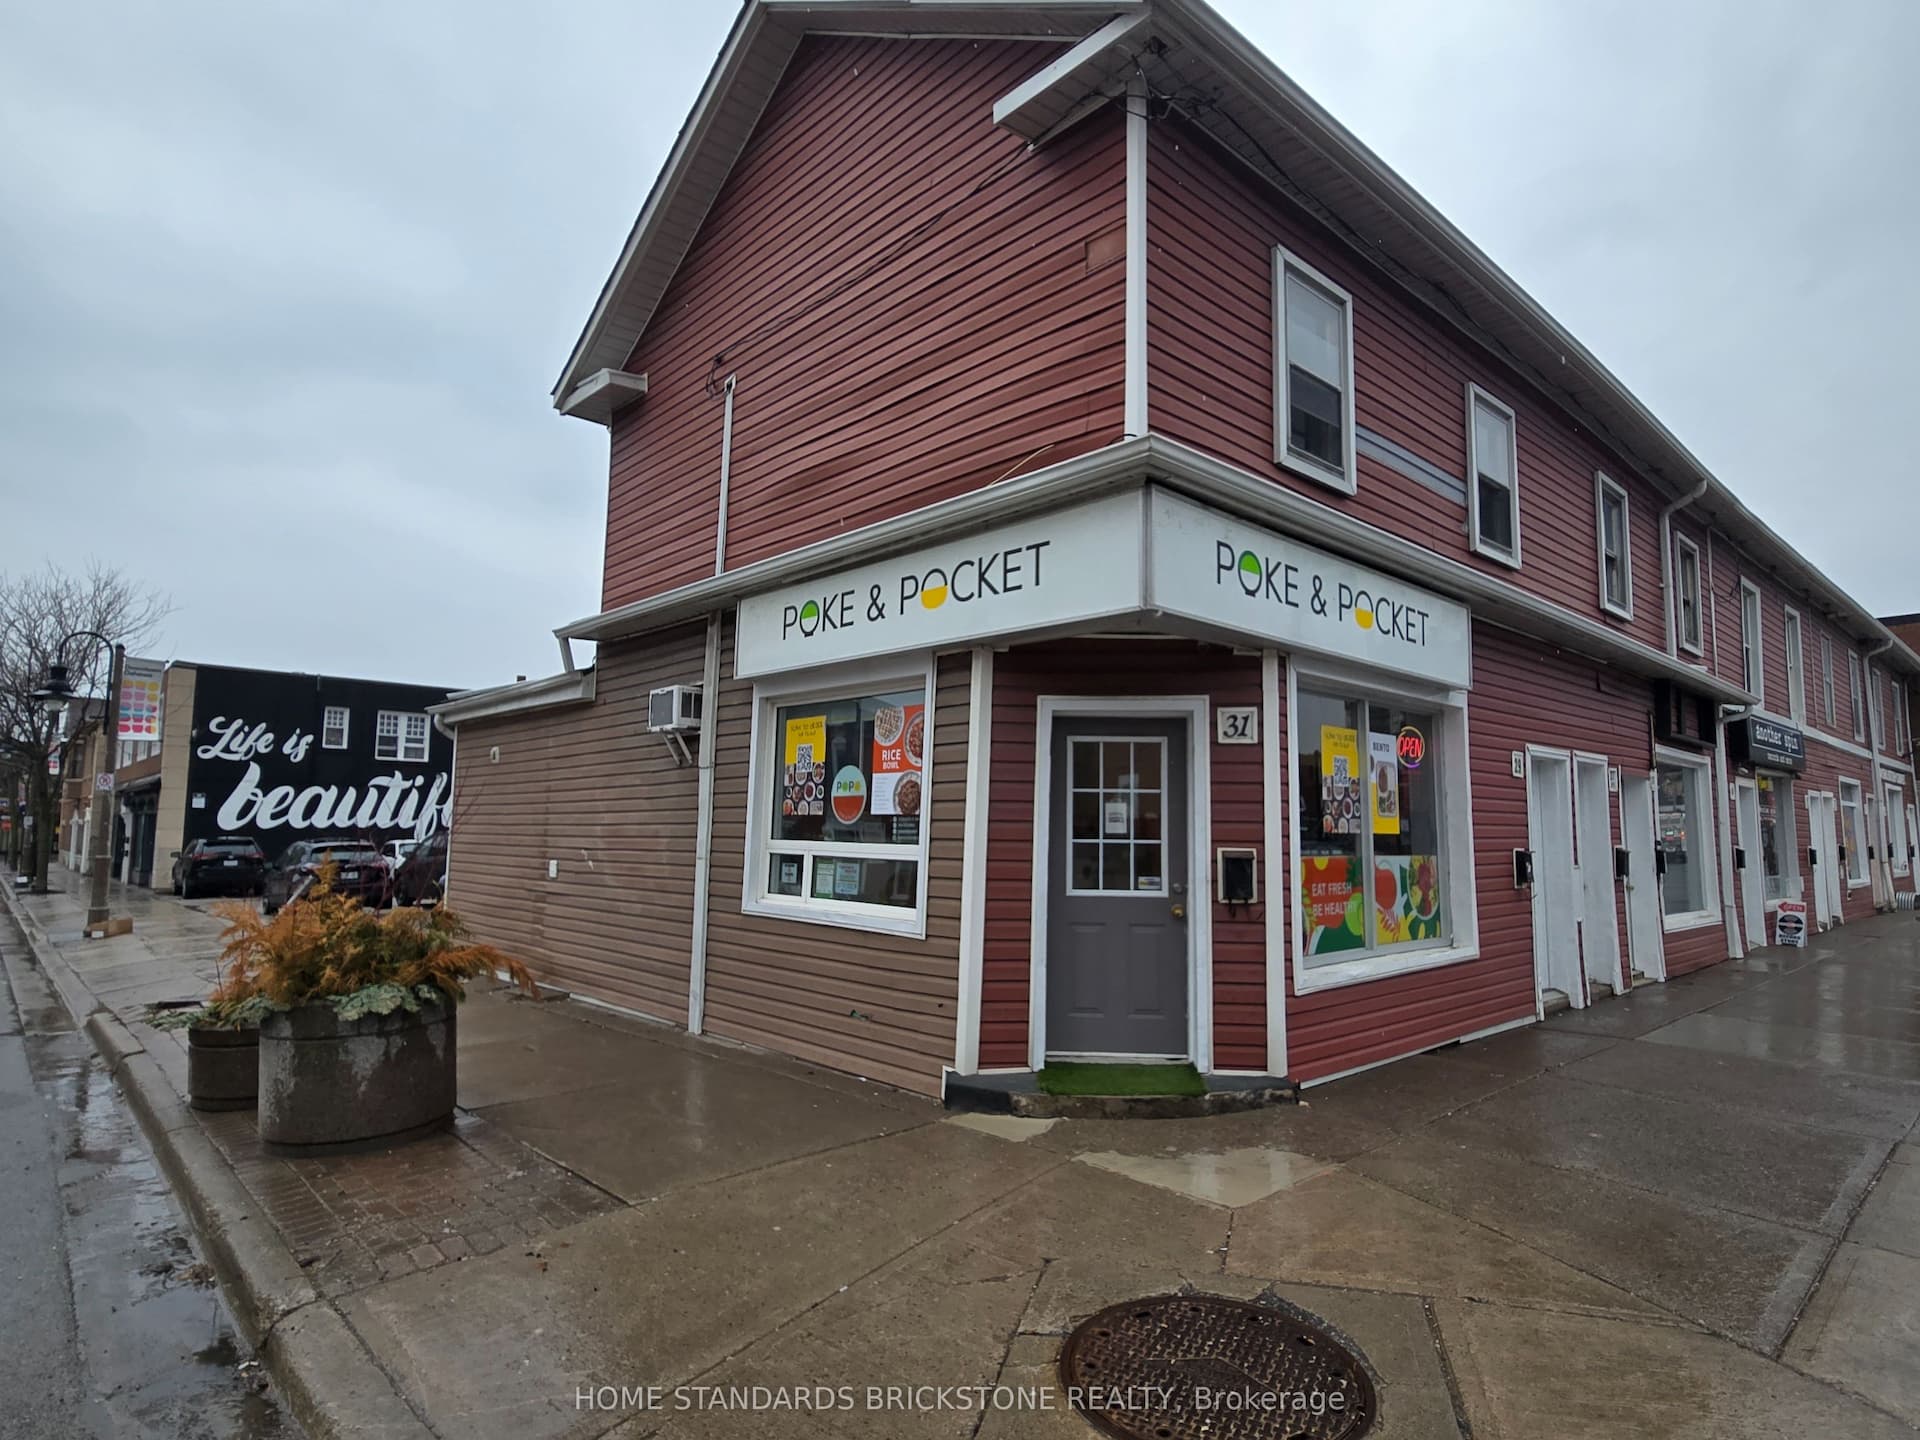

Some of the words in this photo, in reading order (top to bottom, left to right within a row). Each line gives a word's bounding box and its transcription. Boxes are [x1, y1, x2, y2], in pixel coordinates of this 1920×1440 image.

[783, 589, 855, 640] POKE
[866, 583, 886, 622] &
[900, 540, 1050, 615] POCKET
[1216, 540, 1299, 609] POKE
[1311, 575, 1328, 617] &
[1338, 583, 1429, 647] POCKET
[1222, 714, 1250, 738] 31
[197, 716, 274, 761] Life
[282, 728, 314, 763] is
[1372, 741, 1390, 753] BENTO
[1397, 736, 1422, 758] OPEN
[882, 749, 902, 761] RICE
[882, 761, 900, 770] BOWL
[1311, 883, 1326, 897] EAT
[1327, 881, 1352, 897] FRESH
[1312, 903, 1323, 917] BE
